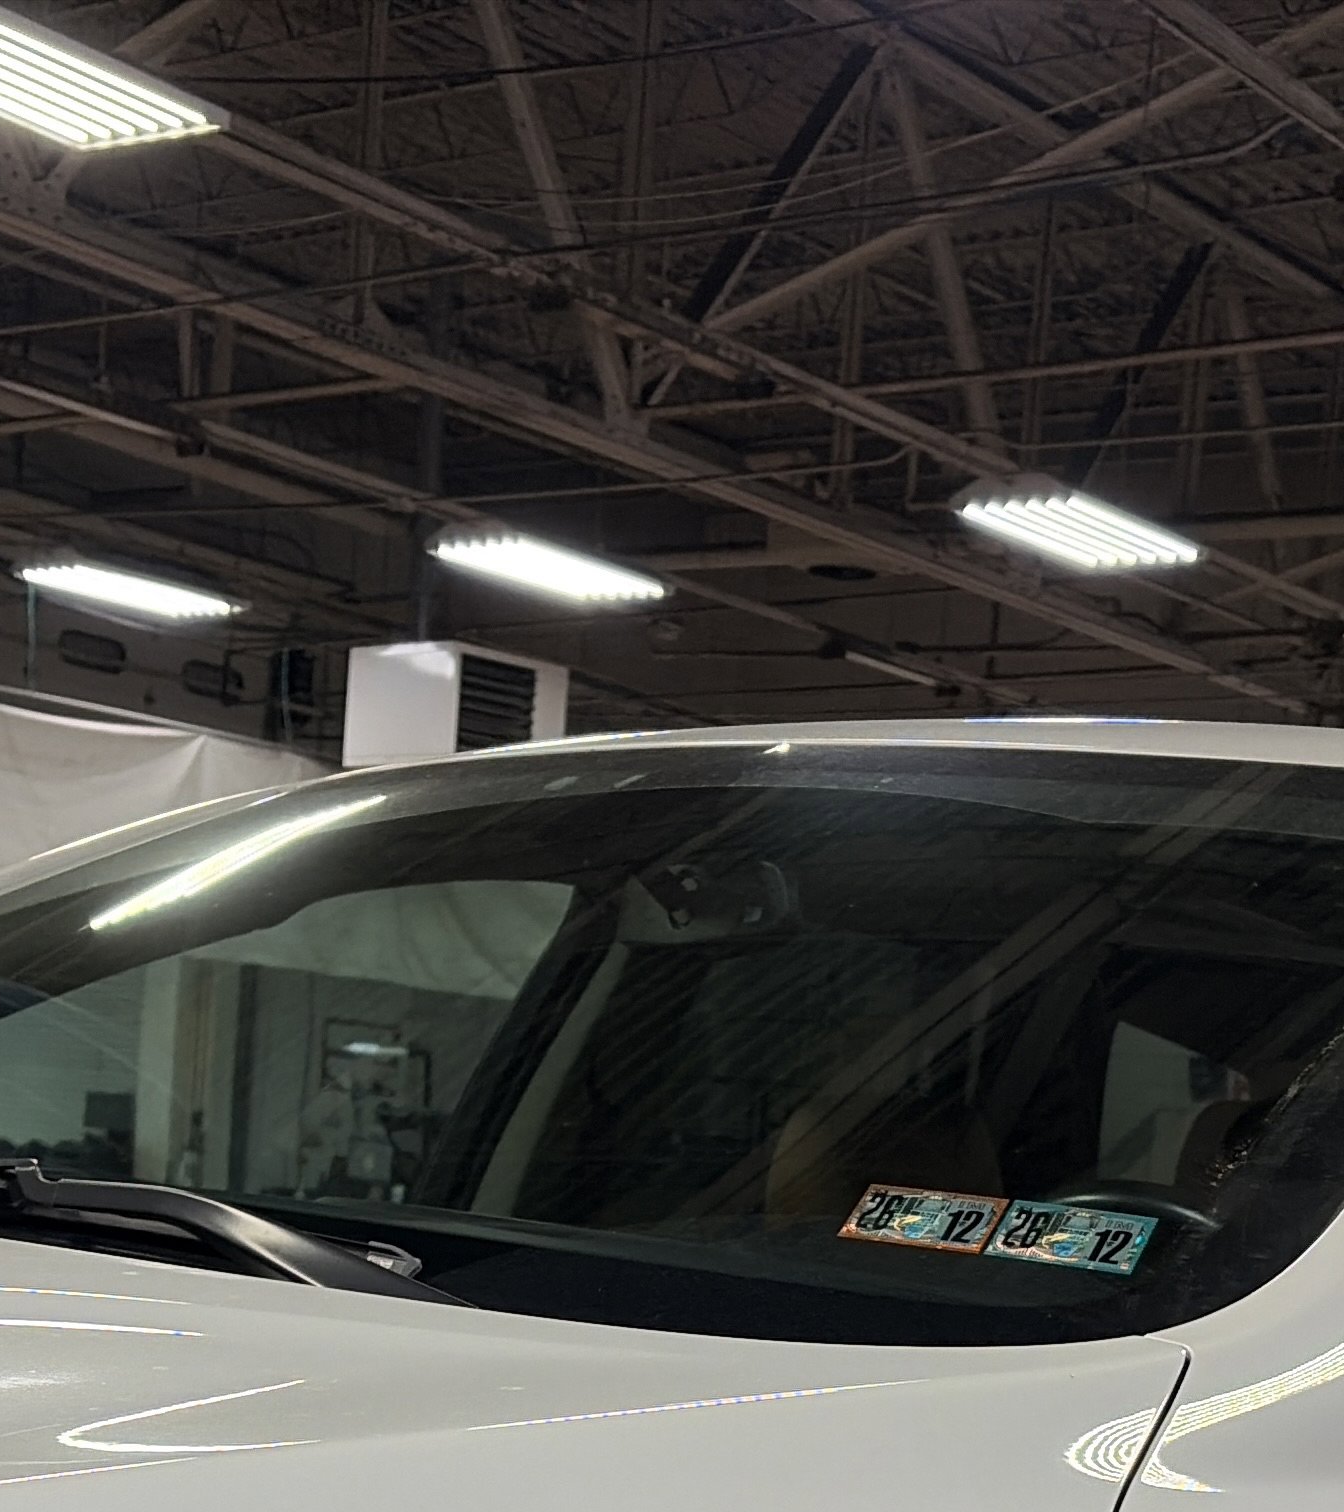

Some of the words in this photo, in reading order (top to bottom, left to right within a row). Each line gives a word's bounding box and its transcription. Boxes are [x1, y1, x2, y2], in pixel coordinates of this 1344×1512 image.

[856, 1191, 904, 1230] 26
[941, 1210, 985, 1243] 12
[1002, 1208, 1050, 1248] 26
[1088, 1229, 1133, 1265] 12
